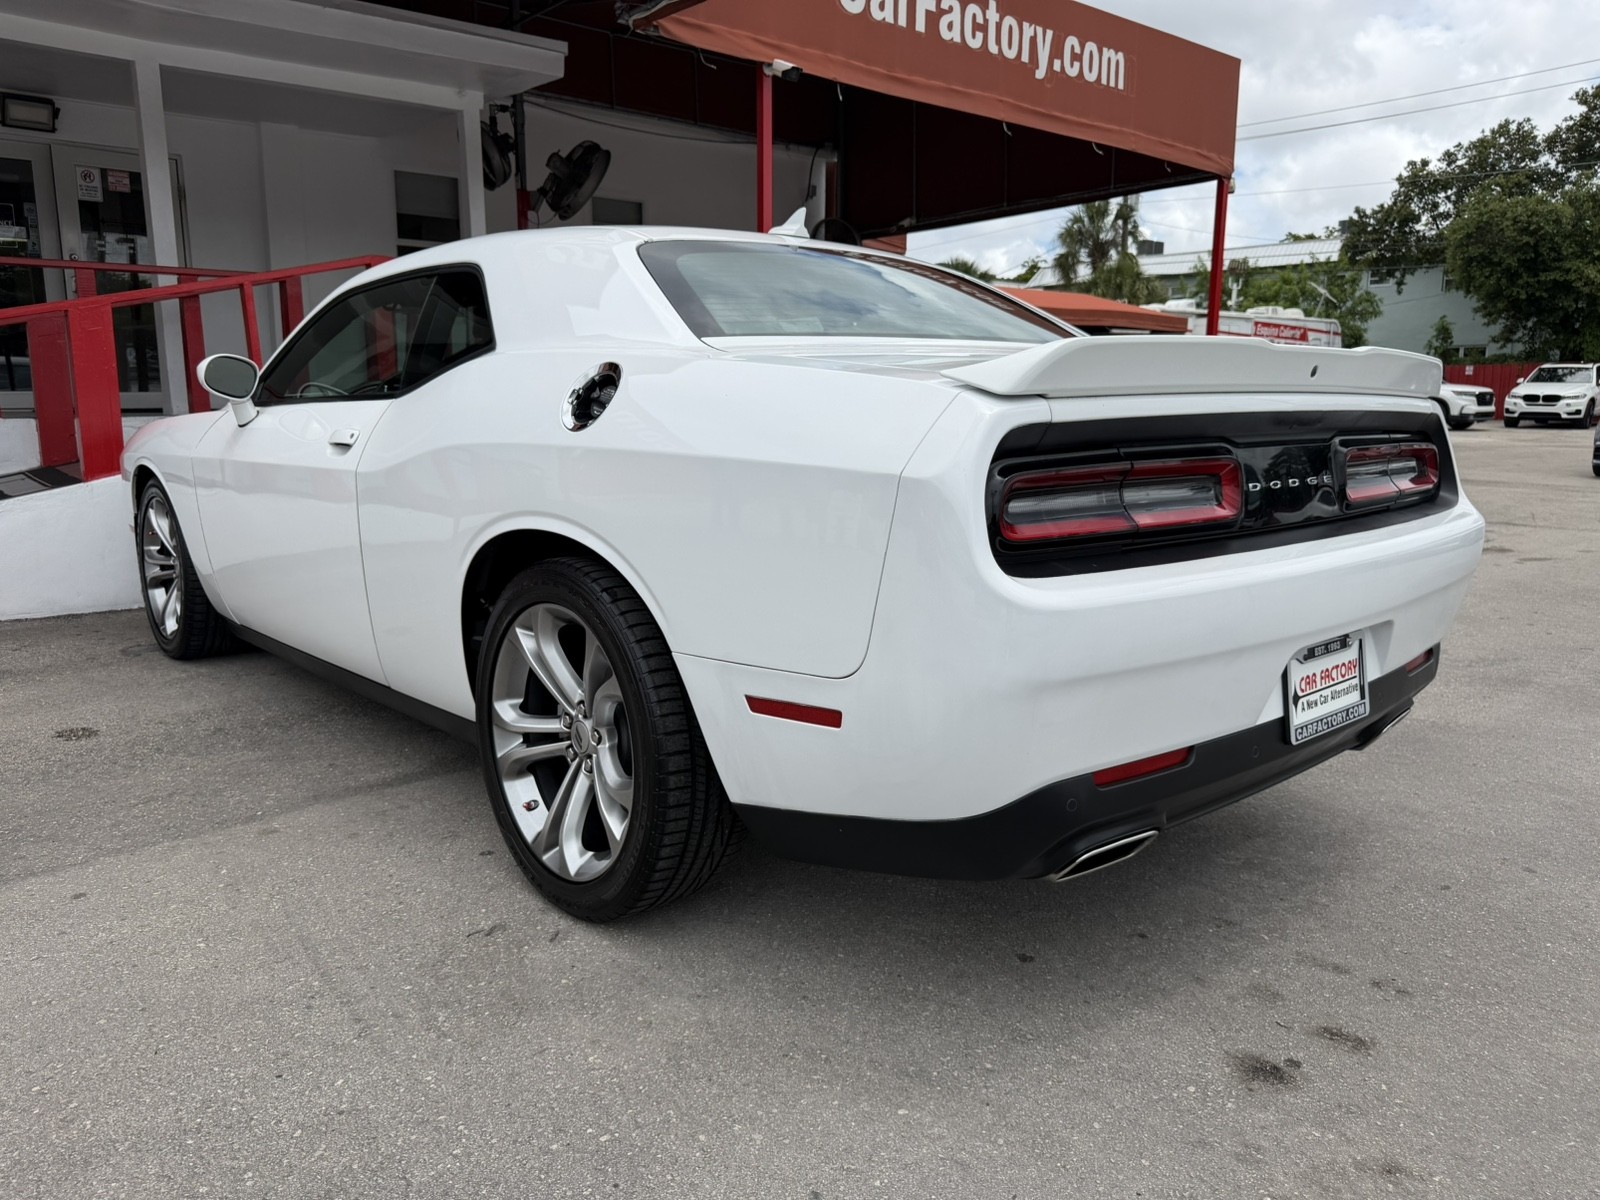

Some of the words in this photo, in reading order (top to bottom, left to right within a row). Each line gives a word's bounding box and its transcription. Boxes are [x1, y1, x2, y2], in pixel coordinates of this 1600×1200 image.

[840, 0, 1125, 90] arFactory.com
[1248, 475, 1332, 492] DODGE
[1314, 646, 1327, 656] EST.
[1299, 672, 1318, 693] CAR
[1320, 658, 1358, 687] FACTORY
[1301, 702, 1306, 712] A
[1306, 699, 1318, 711] New
[1319, 694, 1329, 706] Car
[1330, 682, 1359, 701] Alternative
[1296, 703, 1366, 740] CARFACTORY.COM
